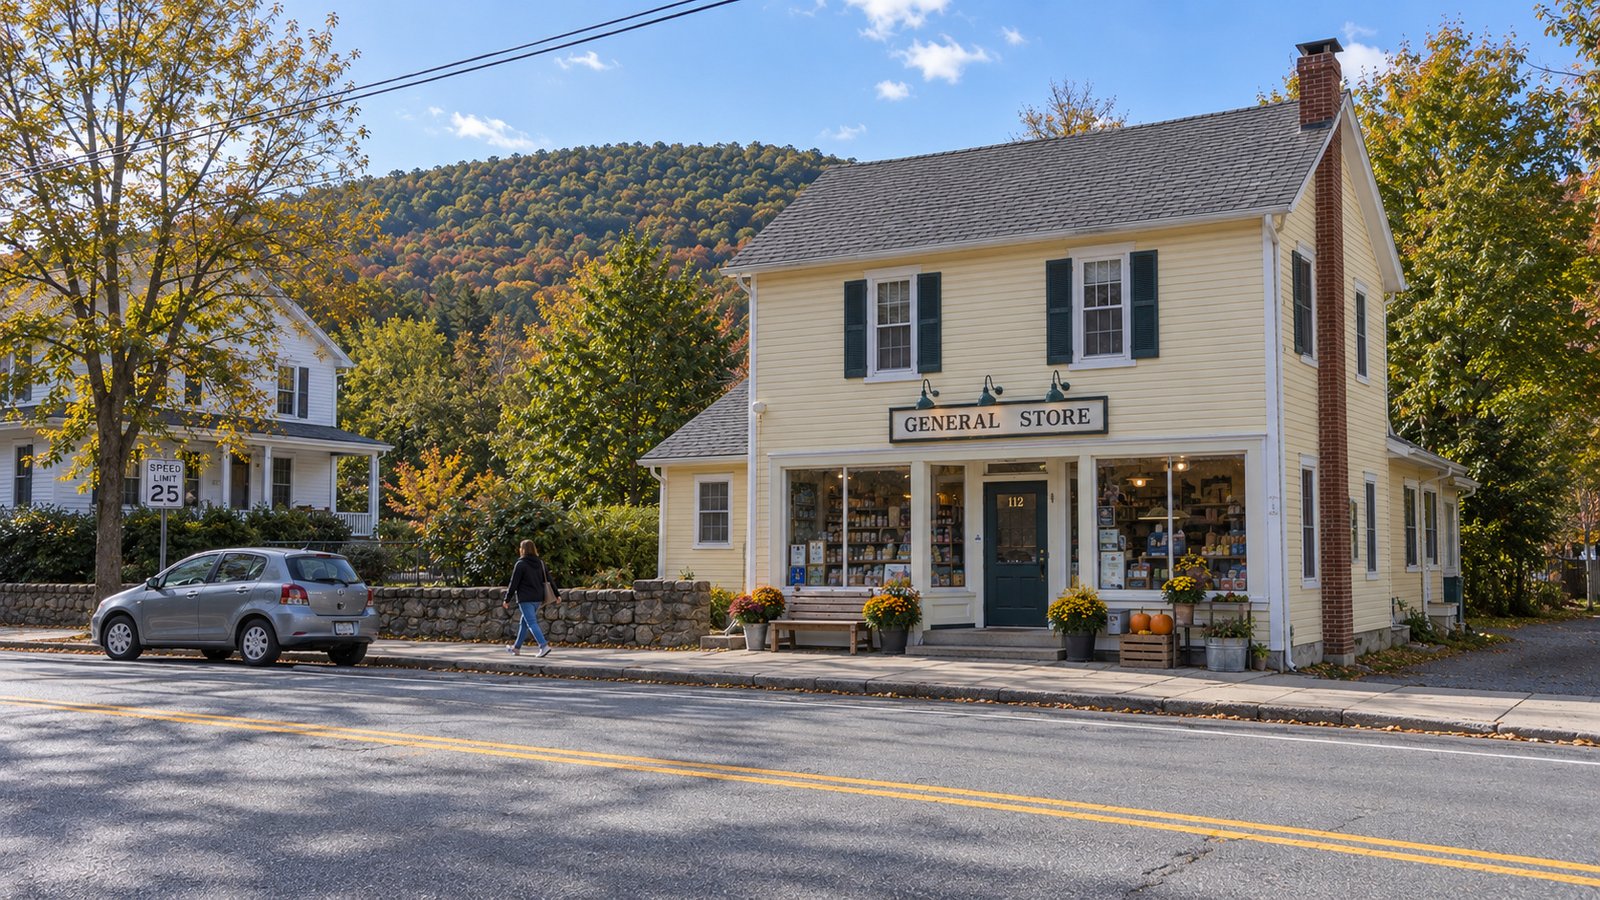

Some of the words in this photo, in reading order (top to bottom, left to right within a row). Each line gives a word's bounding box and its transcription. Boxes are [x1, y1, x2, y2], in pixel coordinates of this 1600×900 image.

[904, 412, 1000, 433] GENERAL
[1019, 407, 1091, 428] STORE
[150, 464, 181, 473] SPEED
[153, 474, 177, 482] LIMIT
[151, 484, 179, 502] 25
[1008, 496, 1024, 507] 112
